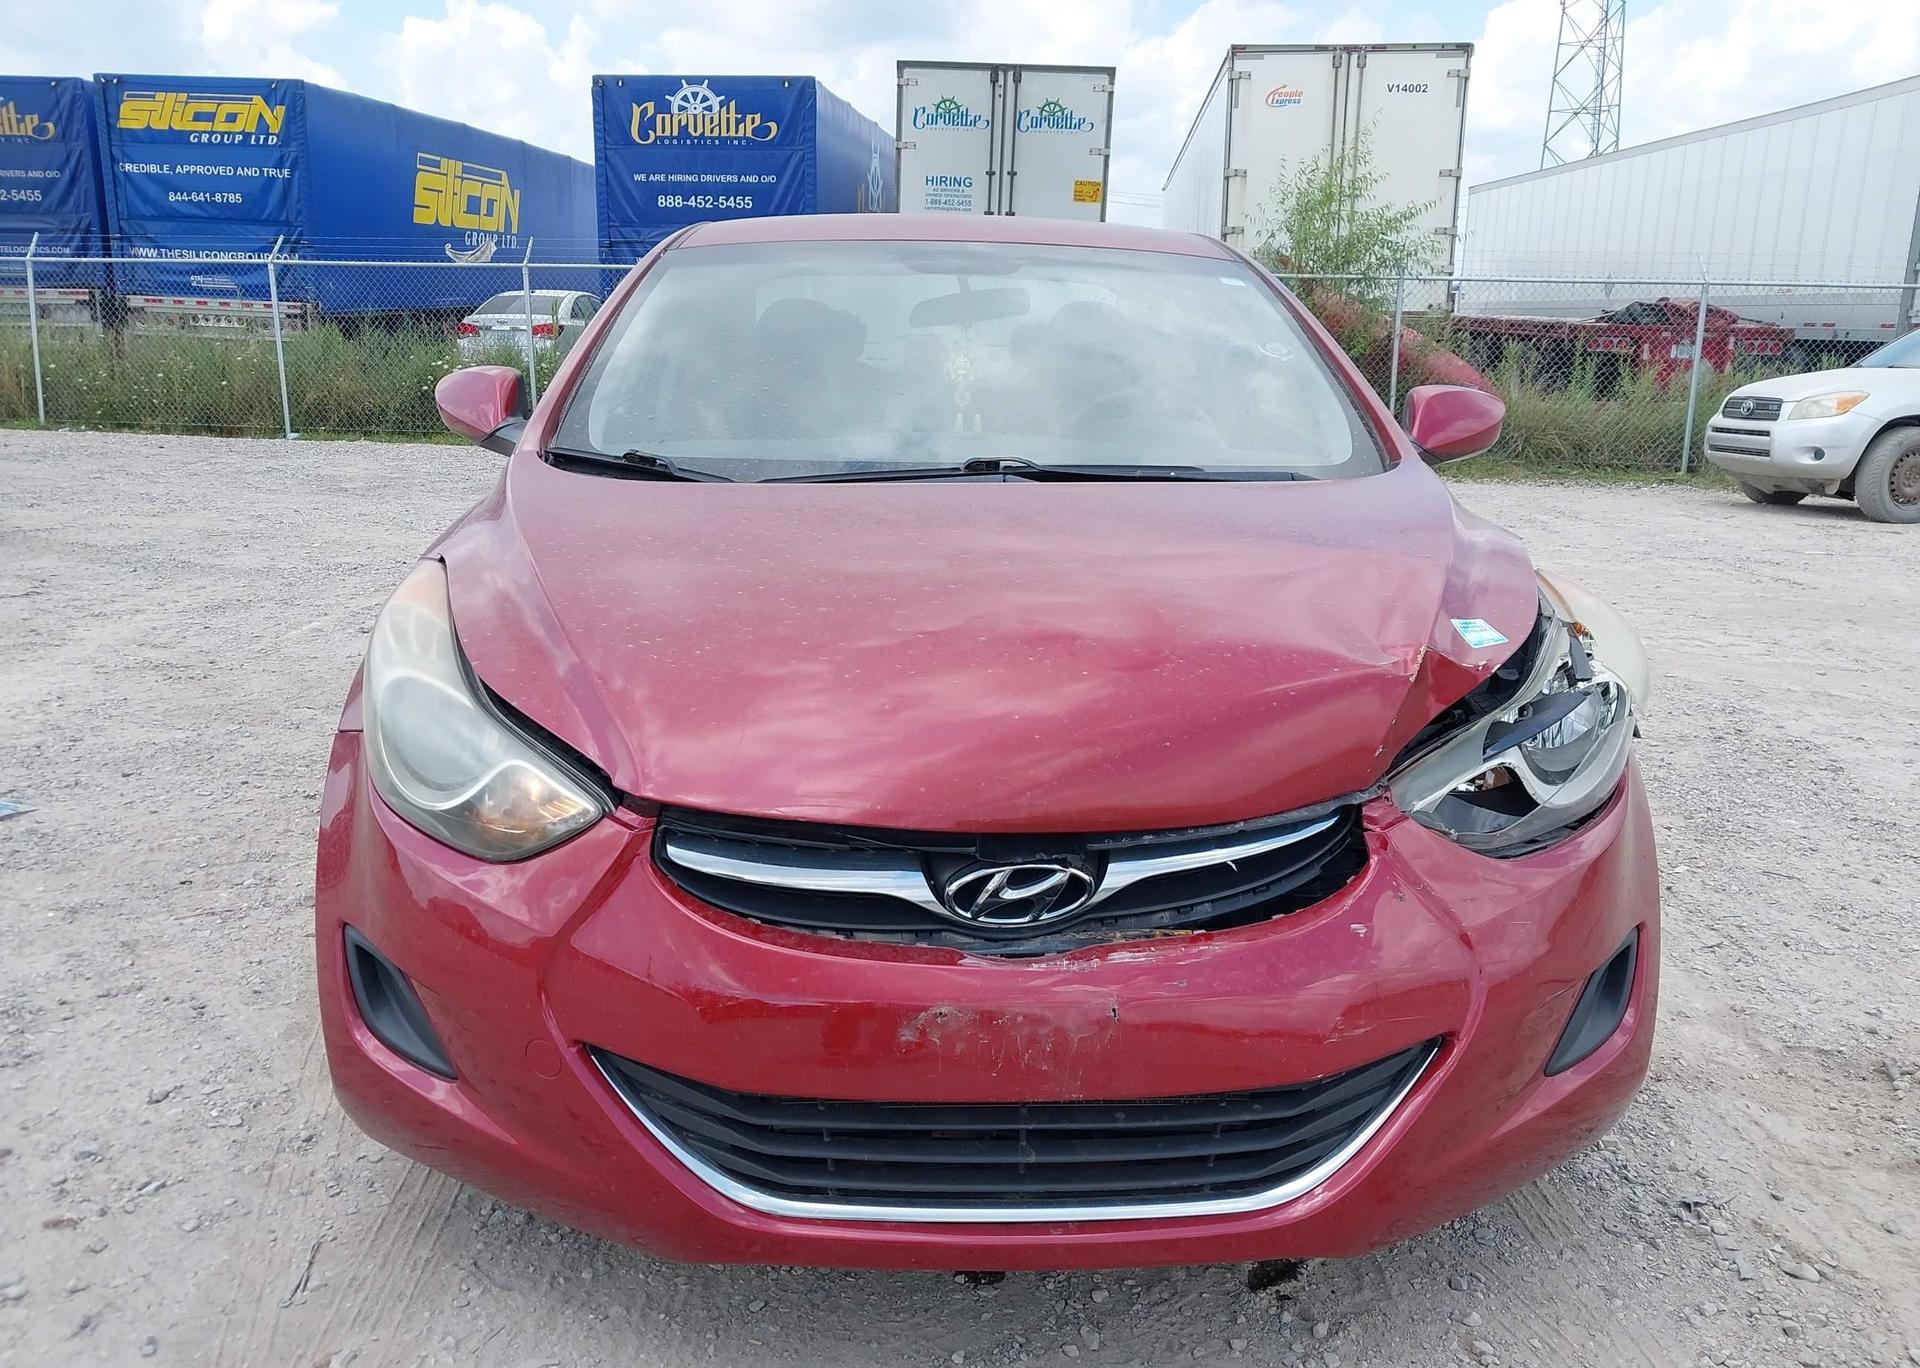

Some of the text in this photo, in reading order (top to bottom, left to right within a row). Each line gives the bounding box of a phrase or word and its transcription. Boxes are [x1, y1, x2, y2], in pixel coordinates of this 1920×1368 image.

[1272, 88, 1303, 98] People
[1387, 84, 1428, 93] V14002
[632, 101, 777, 144] Corvette
[913, 107, 990, 129] Corvette
[1017, 110, 1094, 132] Corvette
[189, 133, 243, 144] GROUP
[27, 170, 44, 178] AND
[119, 162, 292, 178] CREDIBLE, APPROVED AND TRUE
[633, 174, 647, 182] WE
[648, 174, 666, 182] ARE
[668, 174, 699, 182] HIRING
[700, 174, 739, 183] DRIVERS
[739, 175, 759, 183] AND
[925, 175, 973, 188] HIRING
[168, 191, 243, 203] 844-641-8785
[657, 195, 753, 209] 888-452-5455
[925, 199, 972, 207] 1-888-452-5455
[129, 245, 299, 261] WWW.THESILICONGROUPCOM
